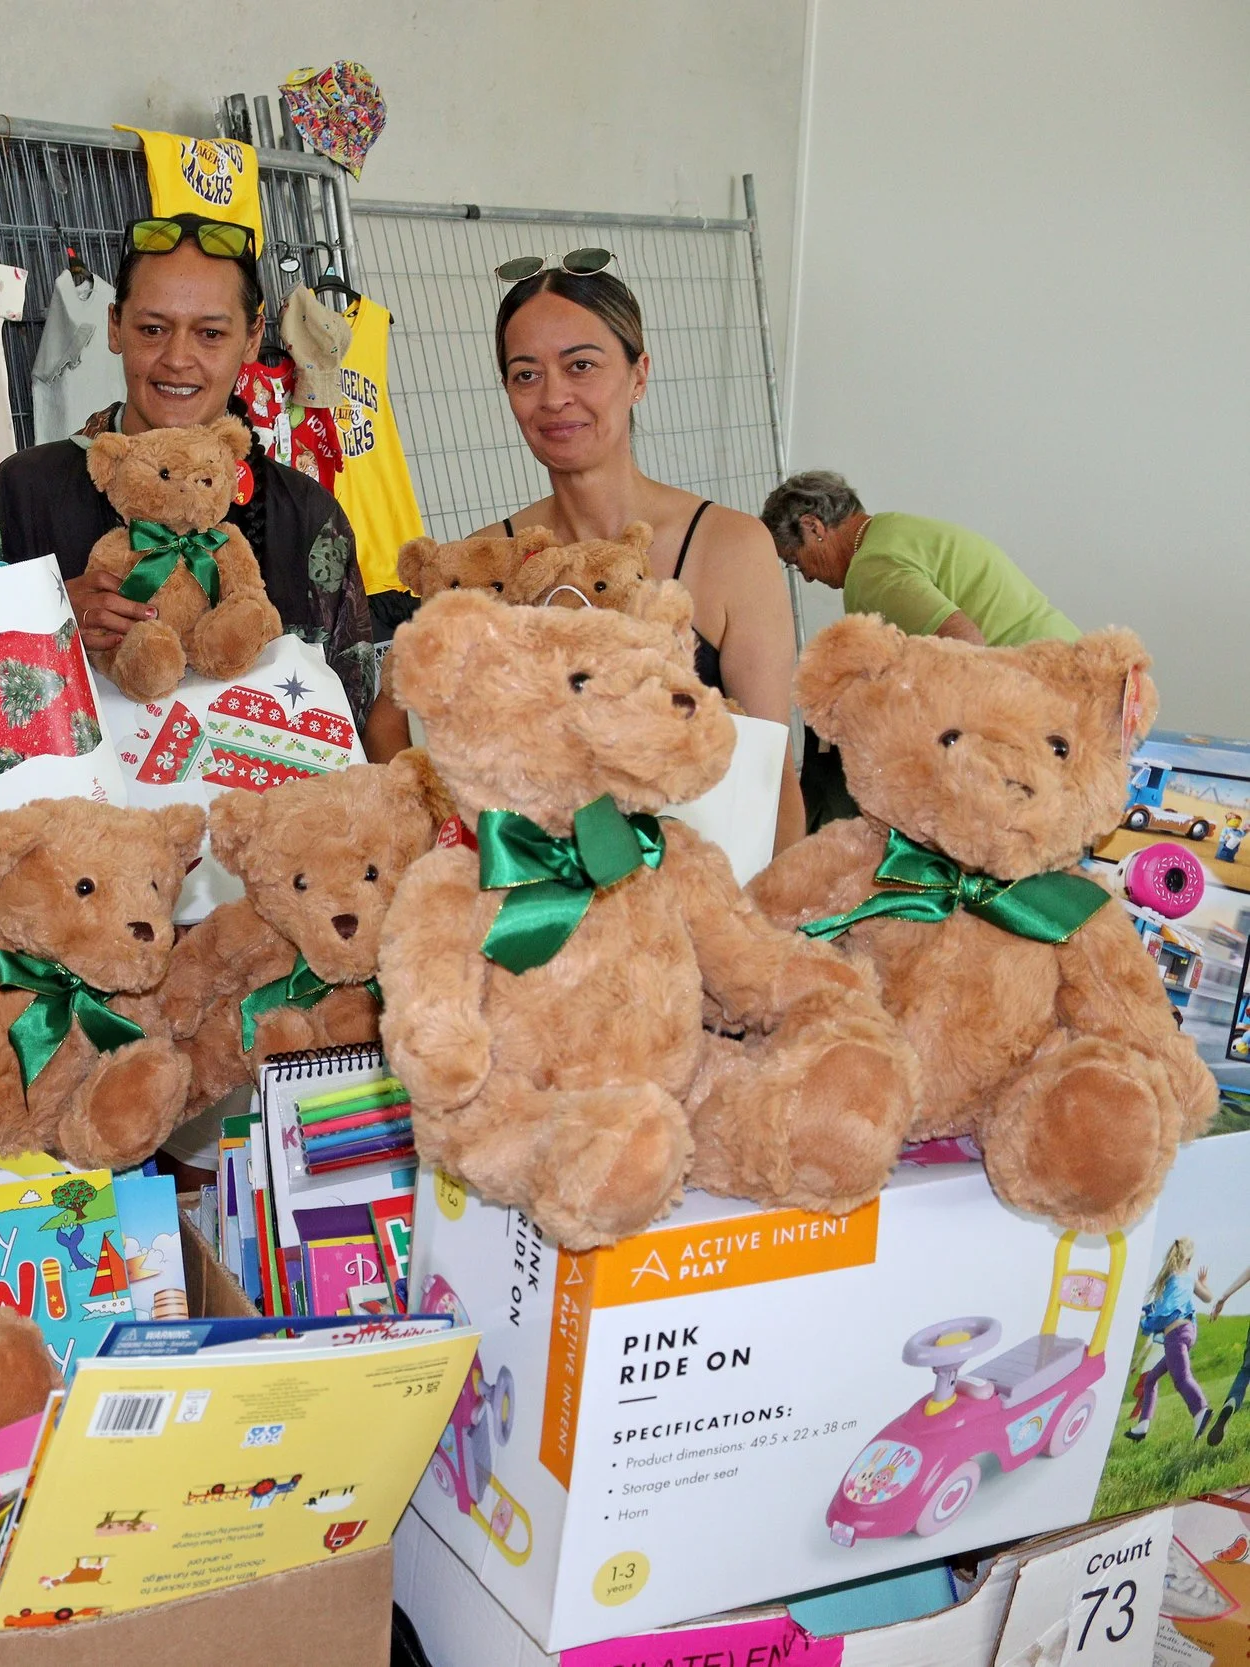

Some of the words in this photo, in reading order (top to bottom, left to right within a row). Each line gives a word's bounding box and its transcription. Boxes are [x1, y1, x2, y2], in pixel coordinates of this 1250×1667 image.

[340, 368, 378, 413] NGELES
[513, 1211, 528, 1274] RIDE
[527, 1223, 543, 1294] PINK
[681, 1232, 761, 1261] ACTIVE
[773, 1216, 849, 1246] INTENT
[679, 1259, 728, 1280] PLAY
[509, 1285, 522, 1327] ON
[559, 1292, 571, 1338] PLAY
[564, 1300, 582, 1377] ACTIVE
[623, 1325, 700, 1355] PINK
[619, 1357, 689, 1385] RIDE
[706, 1346, 752, 1371] ON
[558, 1383, 572, 1457] INTENT
[613, 1405, 793, 1445] SPECIFICATIONS:
[626, 1452, 672, 1469] Product
[676, 1440, 746, 1462] dimensions:
[750, 1432, 778, 1448] 49.5
[781, 1433, 789, 1443] x
[793, 1428, 808, 1441] 22
[812, 1427, 820, 1437] x
[822, 1420, 838, 1435] 38
[841, 1419, 858, 1430] cm
[621, 1477, 671, 1496] Storage
[674, 1471, 711, 1488] under
[713, 1466, 740, 1481] seat
[617, 1506, 650, 1522] Horn
[233, 1558, 266, 1570] choose
[609, 1562, 637, 1582] 1-3
[1086, 1534, 1153, 1576] Count
[140, 1586, 150, 1594] to
[153, 1581, 191, 1593] stickers
[173, 1571, 188, 1580] fun
[606, 1581, 633, 1597] years
[1076, 1578, 1137, 1653] 73
